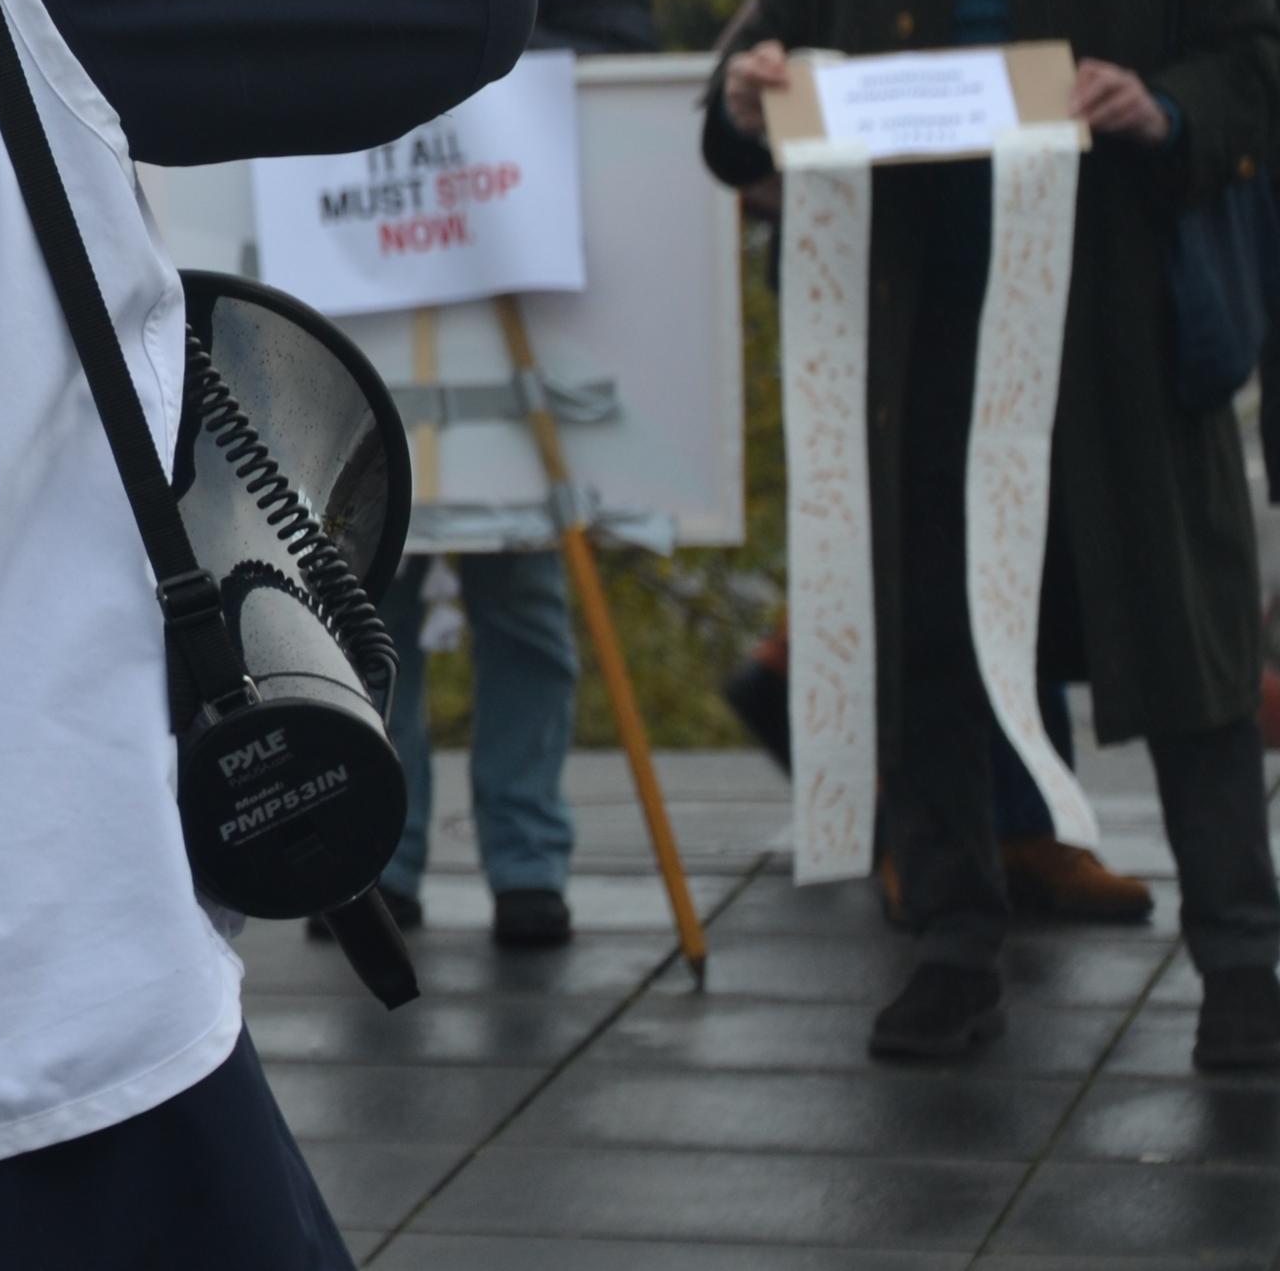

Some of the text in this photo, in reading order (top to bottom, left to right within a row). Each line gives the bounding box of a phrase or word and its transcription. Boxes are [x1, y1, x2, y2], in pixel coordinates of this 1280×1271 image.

[366, 131, 464, 172] IT ALL
[320, 162, 520, 224] MUST STOP
[378, 214, 475, 257] NOW.
[218, 728, 287, 778] PYLE
[219, 764, 348, 842] PMP53IN
